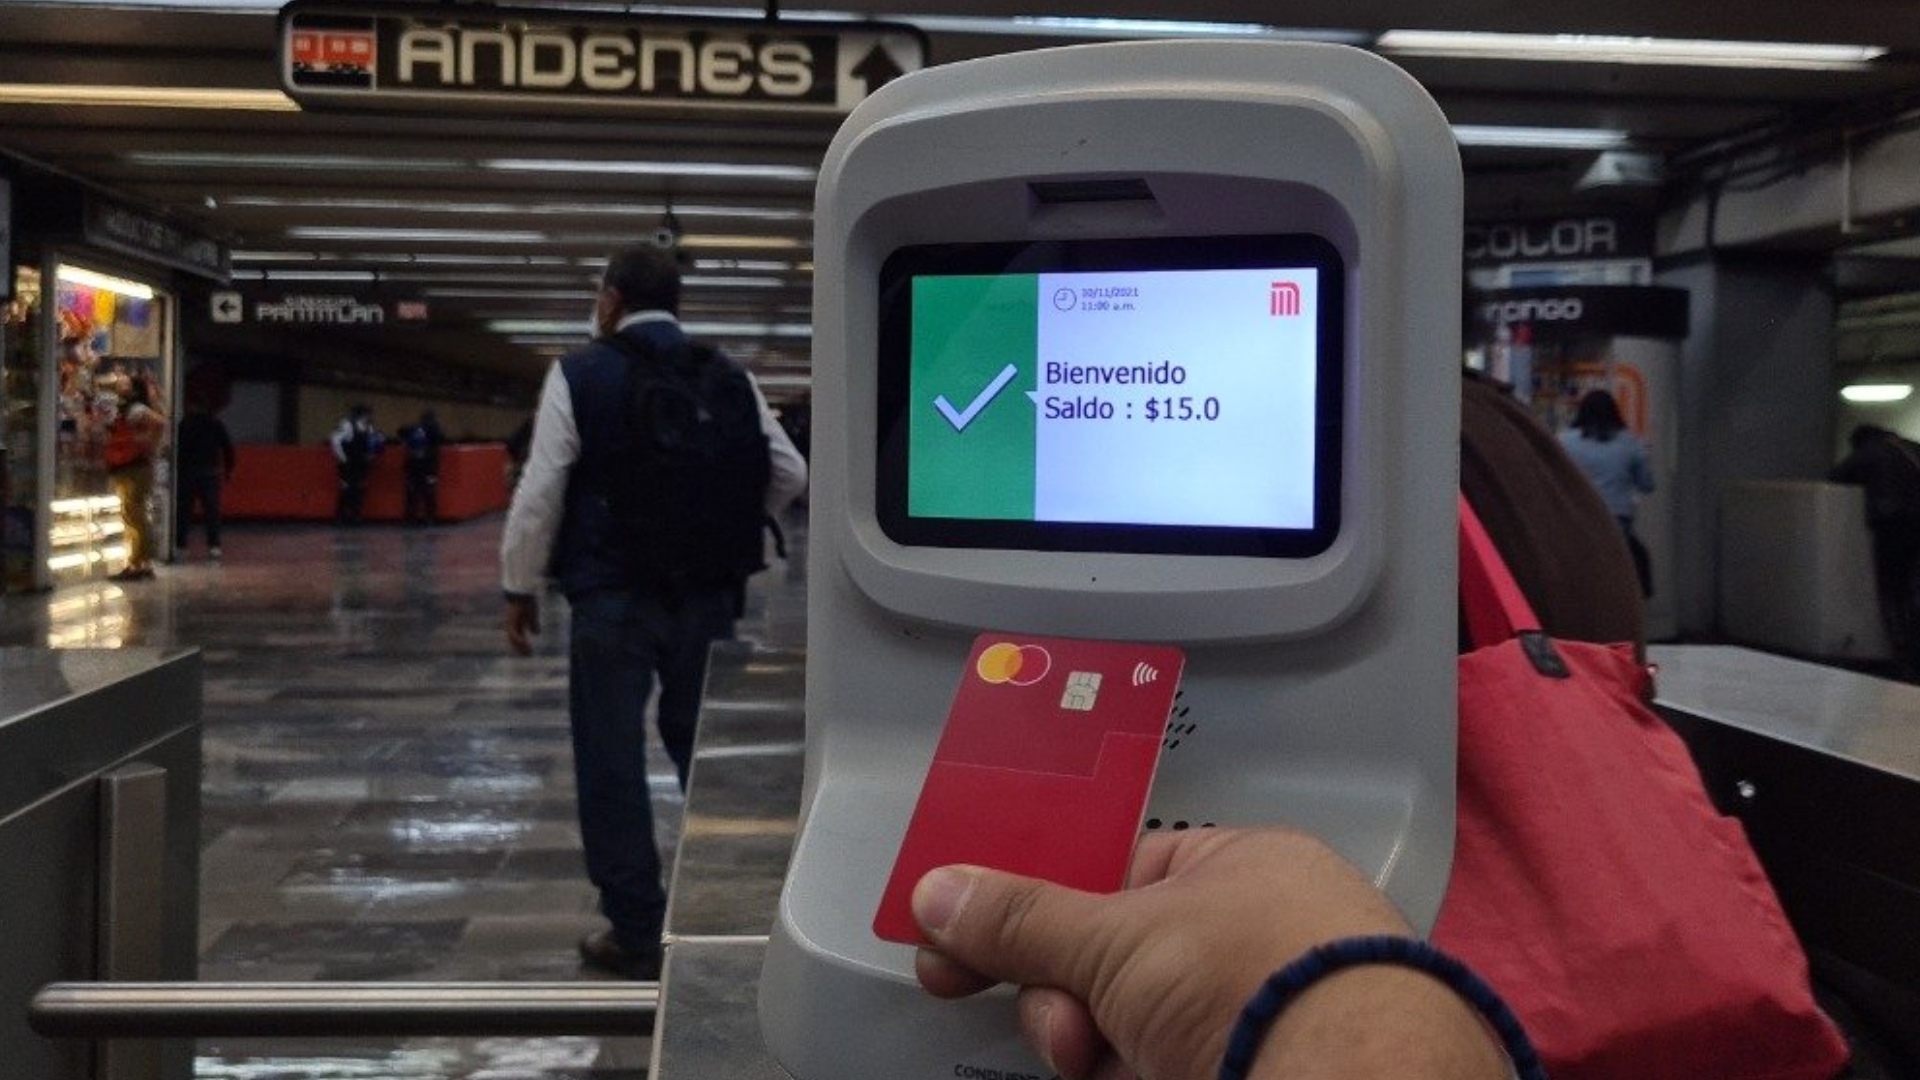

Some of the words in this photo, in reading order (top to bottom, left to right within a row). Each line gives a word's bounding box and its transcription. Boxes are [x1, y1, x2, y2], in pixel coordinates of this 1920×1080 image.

[399, 29, 813, 96] ANDENES
[1046, 361, 1187, 384] Bienvenido
[1045, 396, 1115, 420] Saldo
[1145, 397, 1221, 421] $15.0
